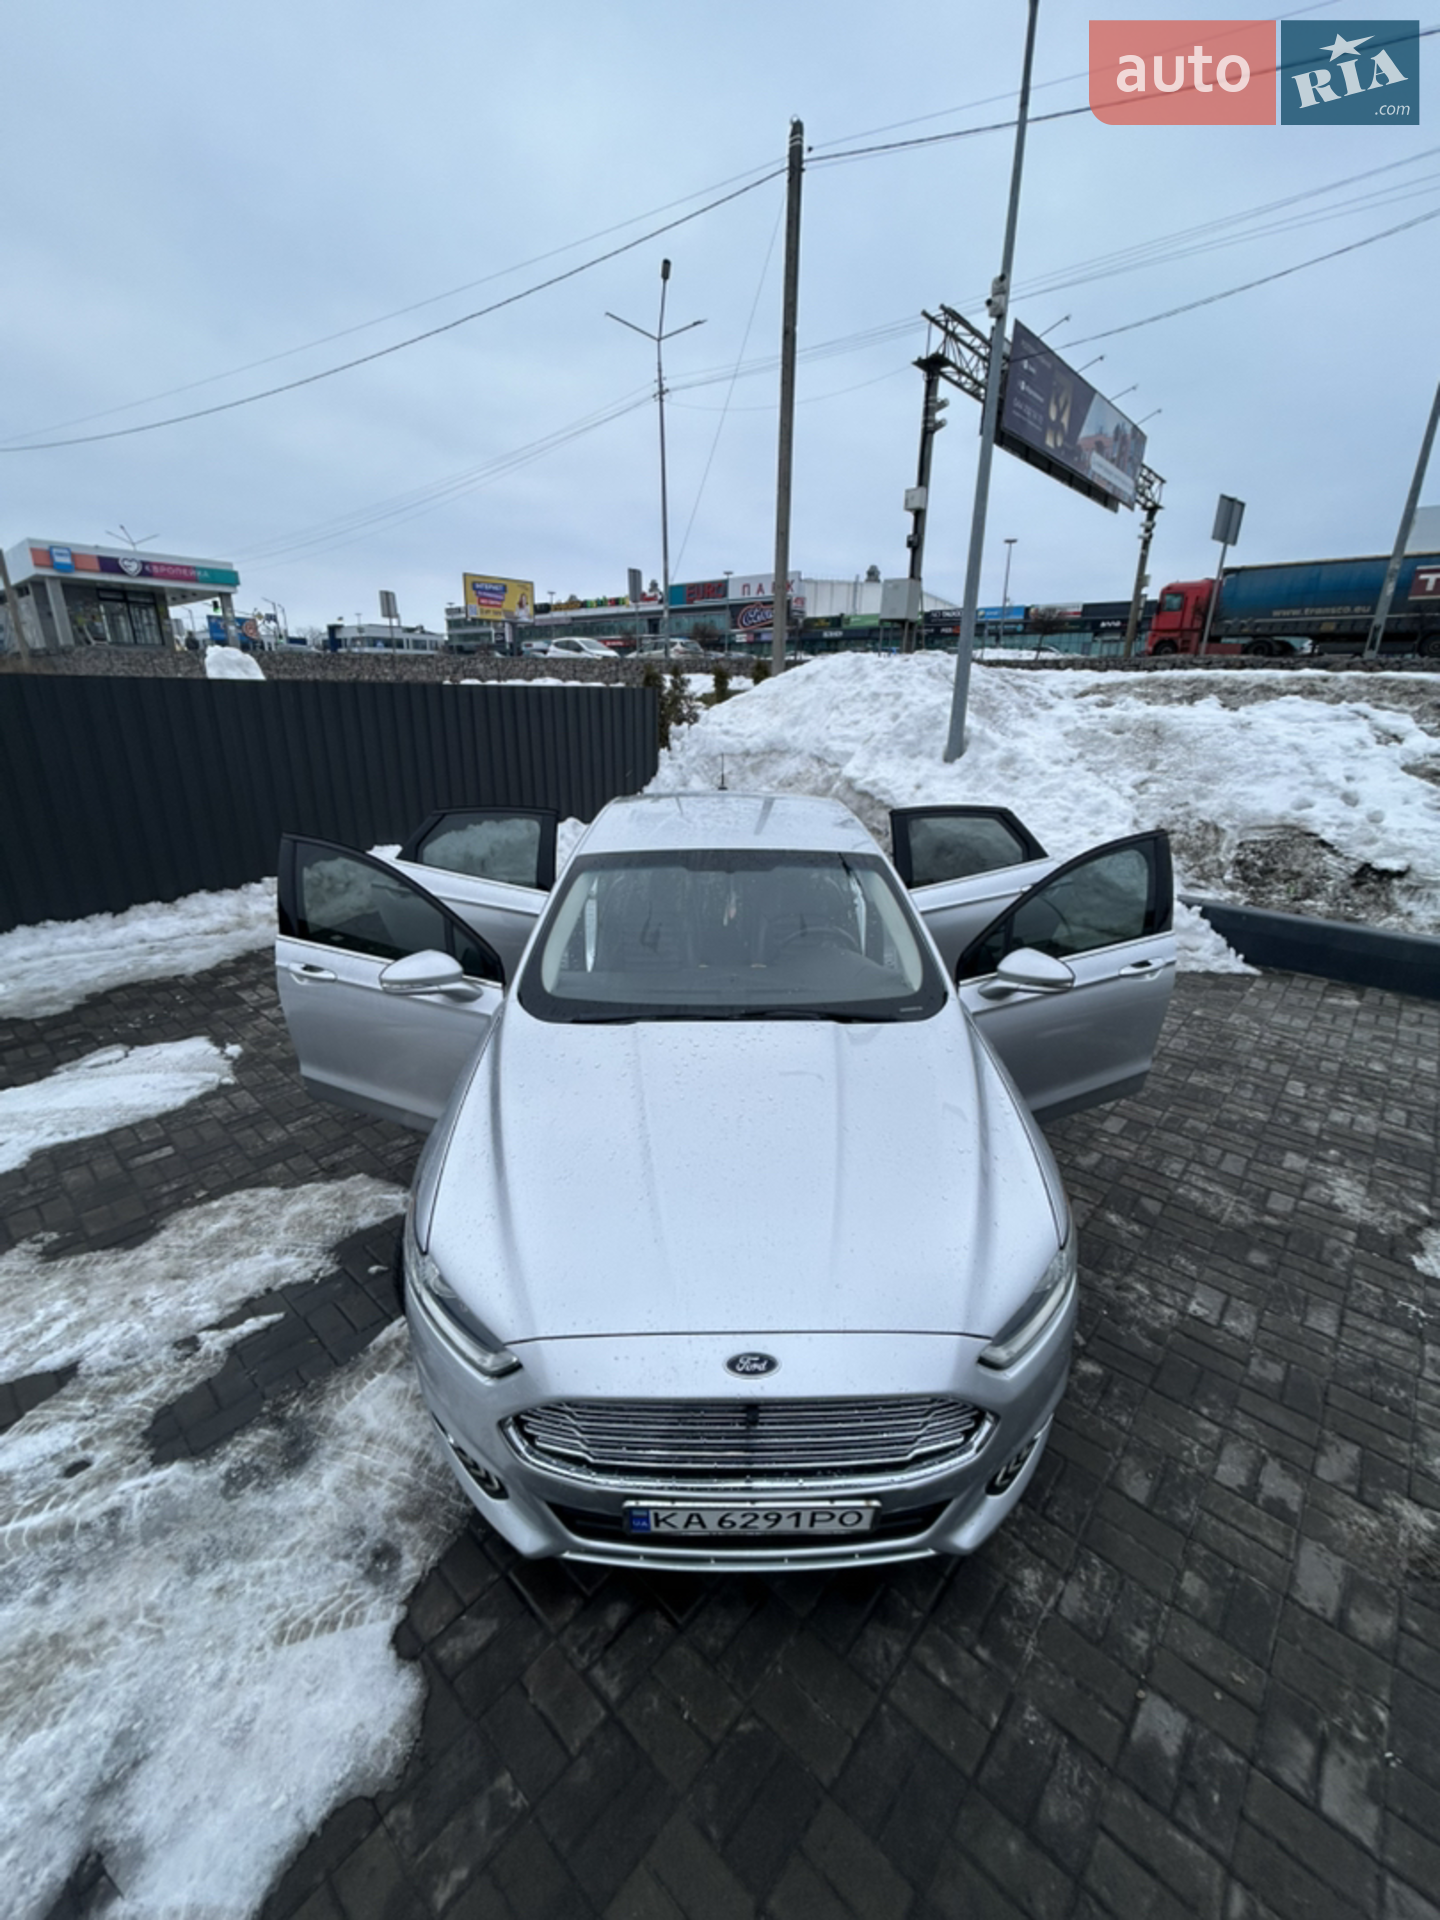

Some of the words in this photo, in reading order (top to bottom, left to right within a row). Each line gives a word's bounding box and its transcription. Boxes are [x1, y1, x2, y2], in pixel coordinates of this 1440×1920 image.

[1272, 604, 1372, 618] www.transco.eu
[735, 1355, 769, 1372] Ford
[632, 1519, 649, 1528] UA
